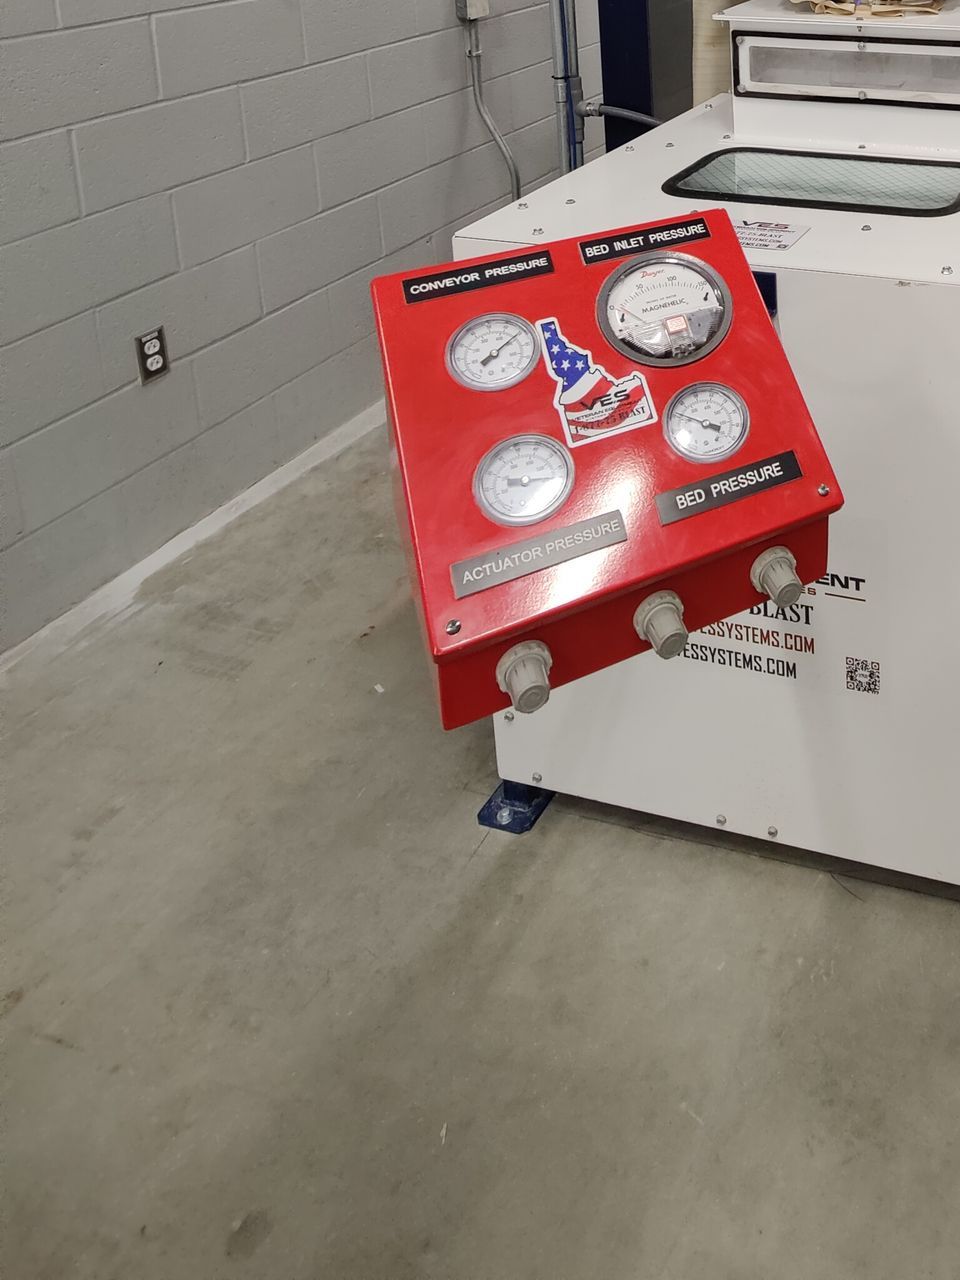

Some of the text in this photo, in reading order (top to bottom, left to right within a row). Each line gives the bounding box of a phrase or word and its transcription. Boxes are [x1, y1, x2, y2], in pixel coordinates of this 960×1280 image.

[585, 224, 706, 257] BED INLET PRESSURE
[410, 257, 549, 295] CONVEYOR PRESSURE
[642, 298, 687, 314] MAGNEHELIC
[580, 389, 630, 410] VES
[675, 462, 784, 510] BED PRESSURE
[462, 519, 621, 585] ACTUATOR PRESSURE
[677, 642, 797, 679] ESSYSTEMS.COM
